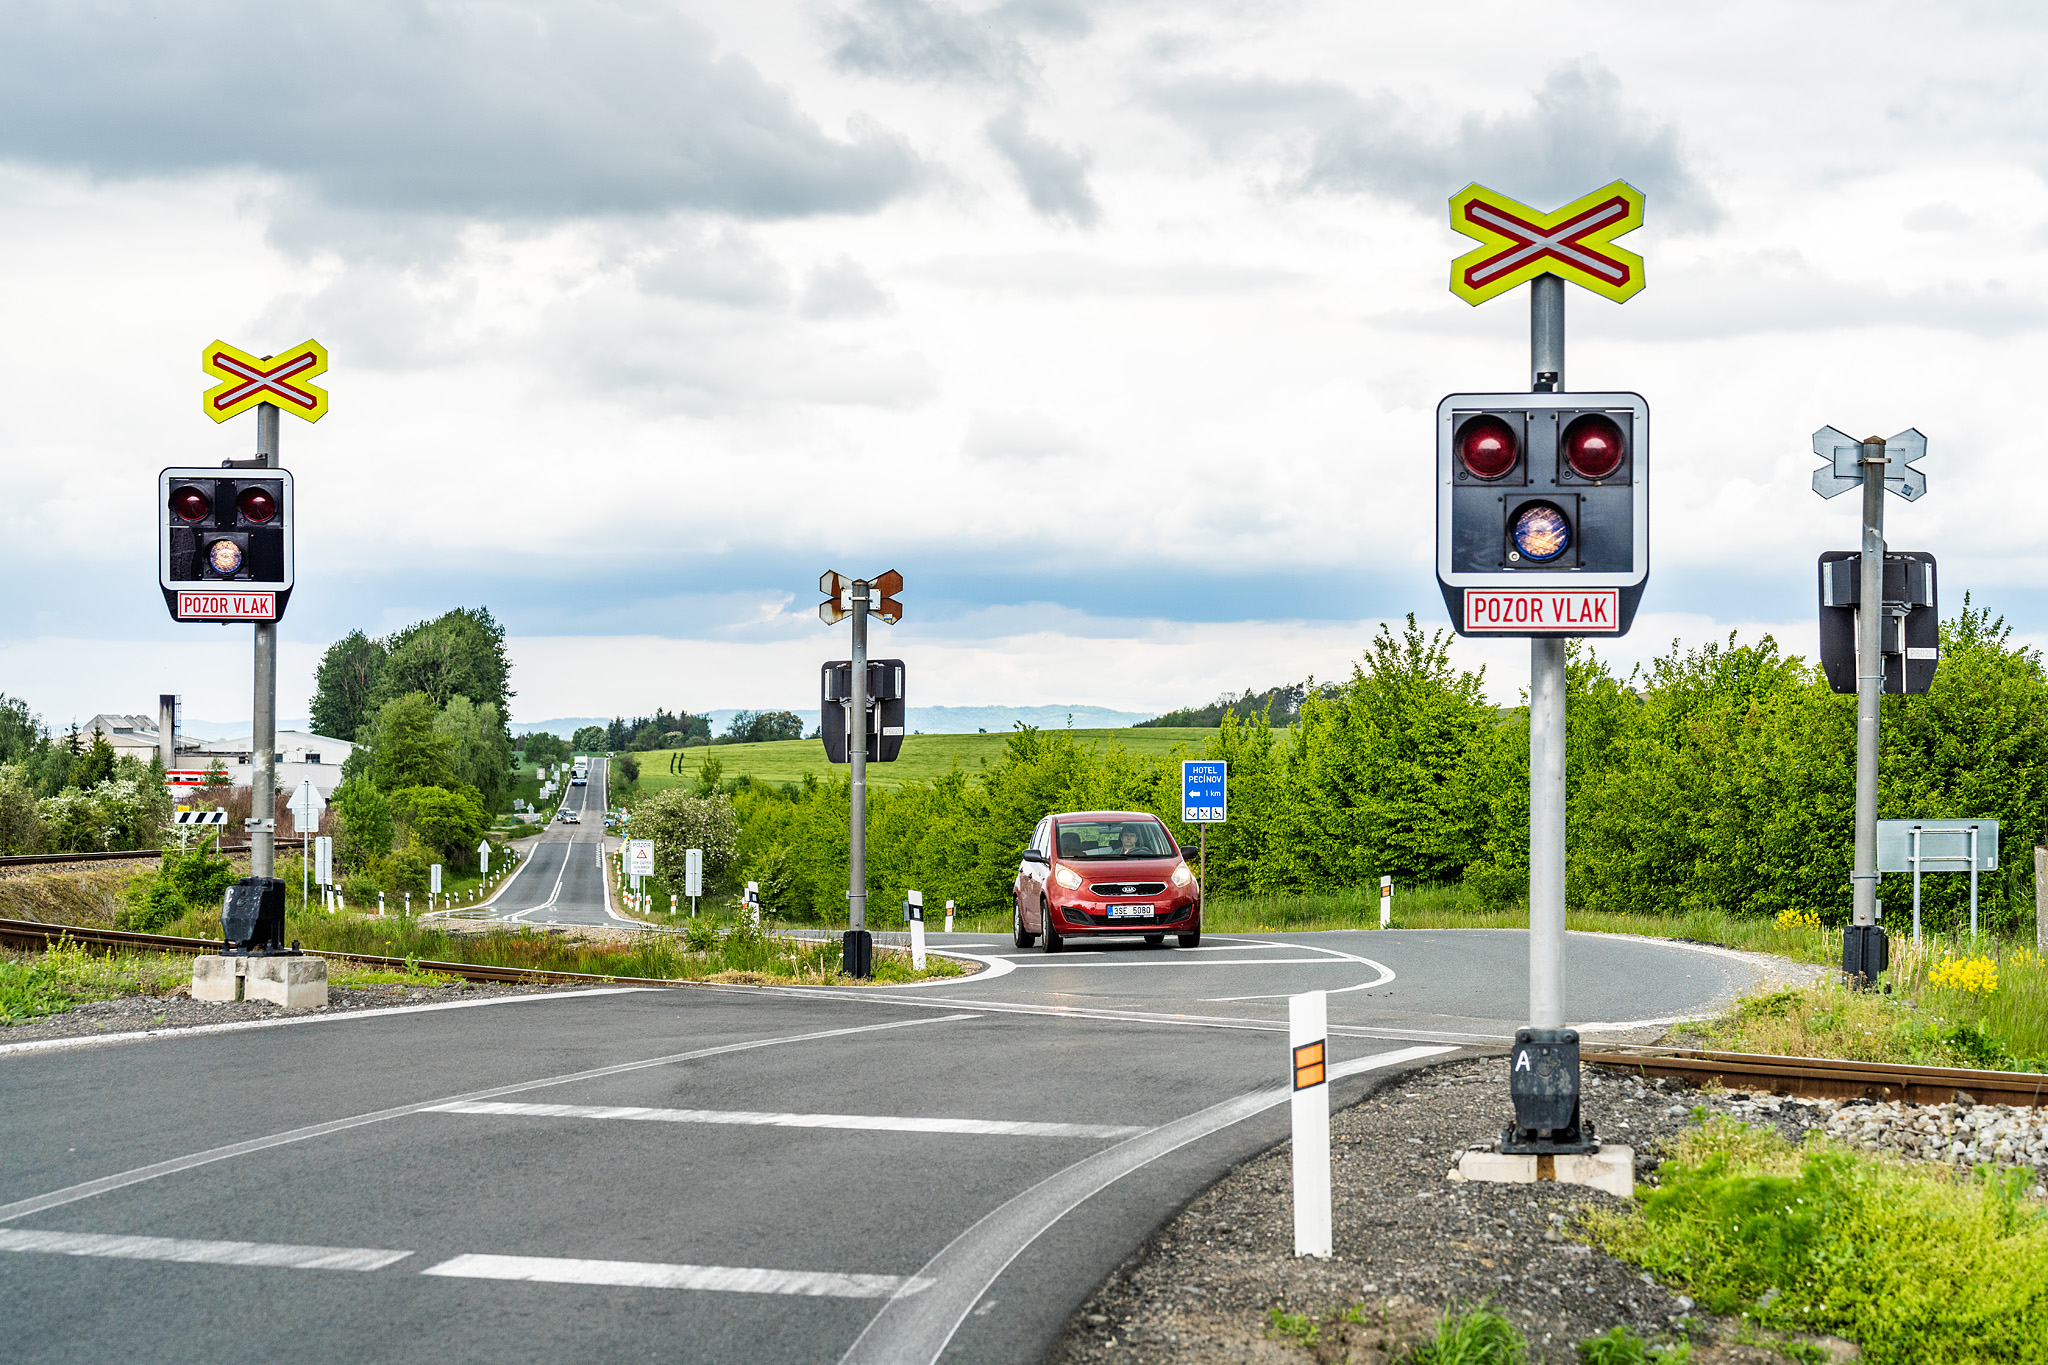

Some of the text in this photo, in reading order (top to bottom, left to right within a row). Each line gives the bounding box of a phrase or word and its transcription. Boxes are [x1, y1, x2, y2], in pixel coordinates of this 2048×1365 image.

[184, 597, 269, 614] POZOR VLAK
[1474, 597, 1608, 623] POZOR VLAK
[1189, 774, 1222, 783] PECÍNOV
[225, 888, 234, 903] C
[1515, 1049, 1531, 1072] A
